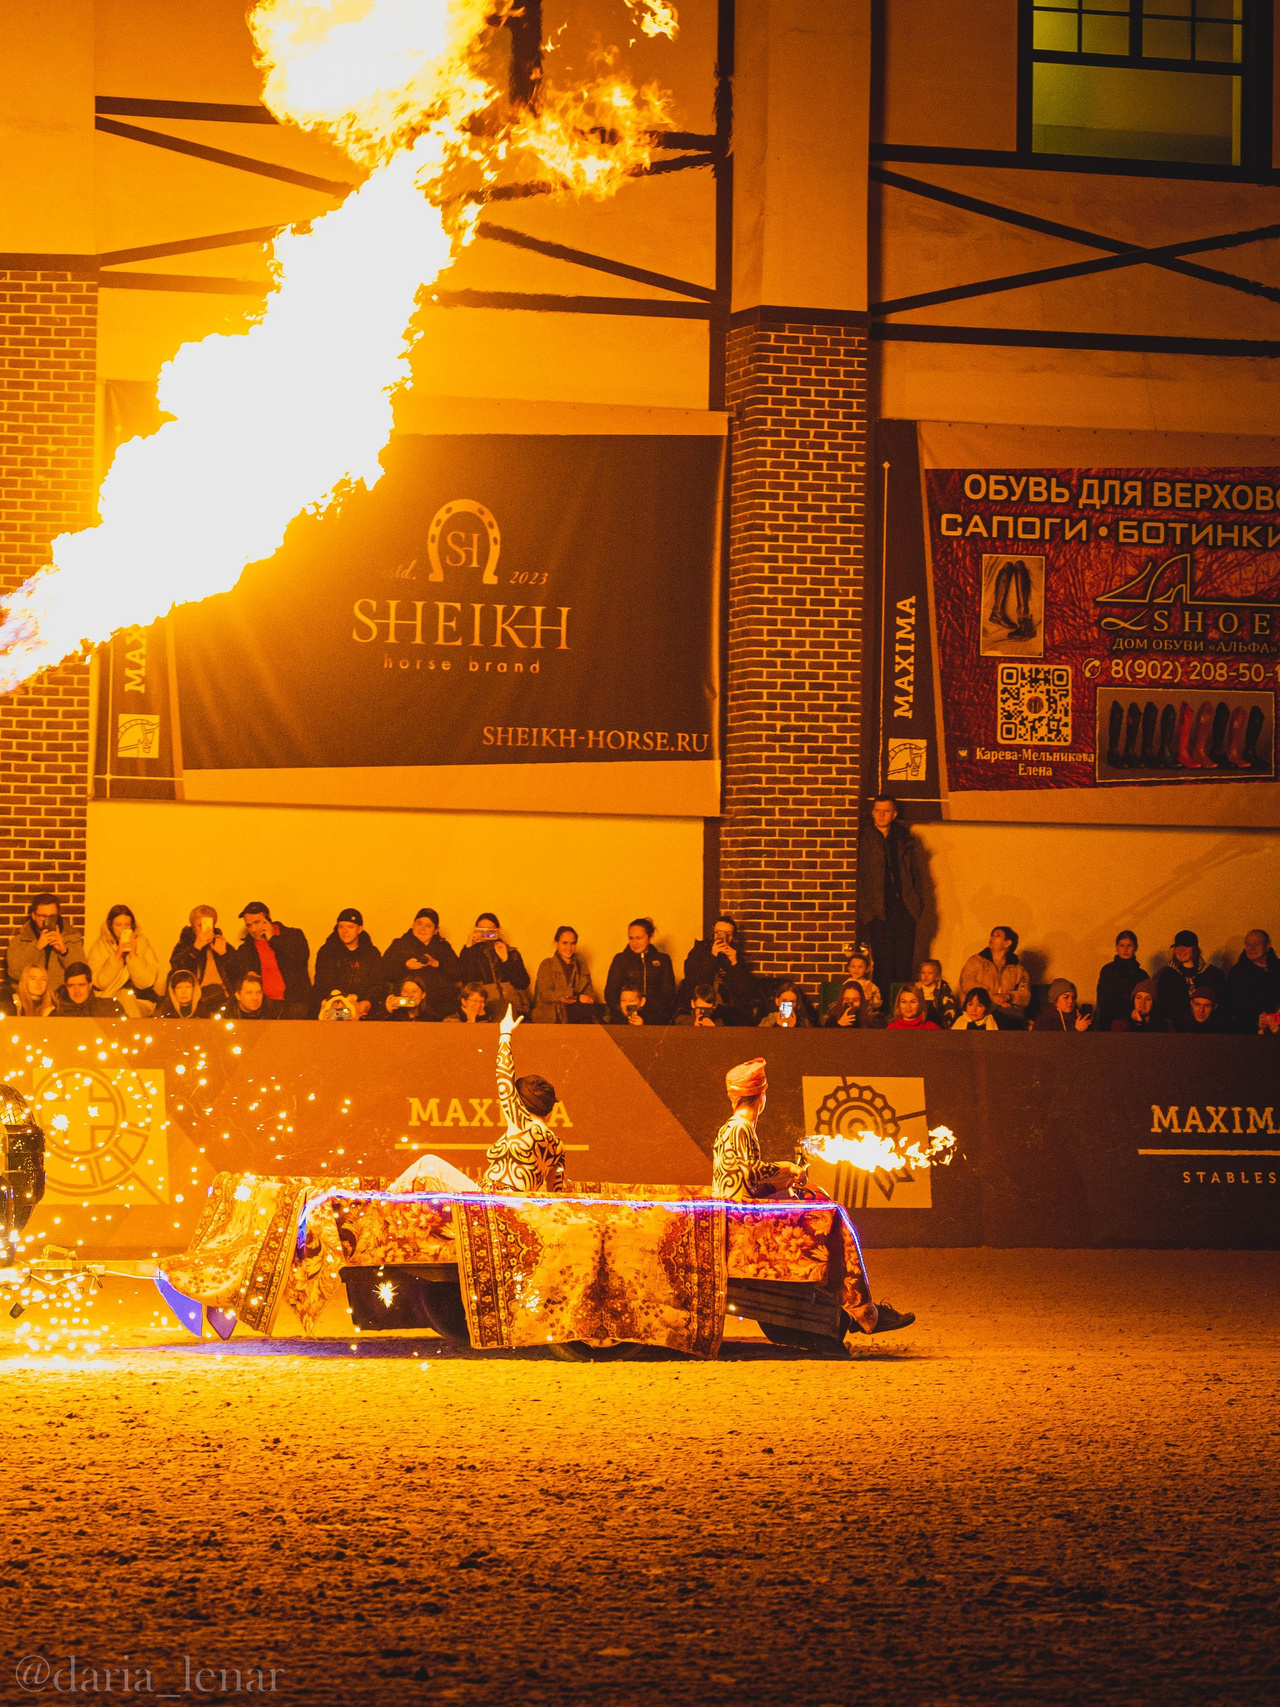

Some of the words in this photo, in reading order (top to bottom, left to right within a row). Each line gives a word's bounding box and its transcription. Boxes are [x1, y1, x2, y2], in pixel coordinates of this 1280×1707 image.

[964, 474, 1070, 503] ОБУВЬ
[1078, 478, 1143, 509] ДЛЯ
[1153, 481, 1280, 511] ВЕРХОВ
[940, 513, 1087, 541] САПОГИ
[509, 571, 549, 585] 2023
[352, 598, 572, 650] SHEIKH
[893, 595, 916, 719] MAXIMA
[1113, 638, 1148, 650] ДОМ
[1152, 639, 1204, 651] ОБУВИ
[383, 652, 451, 671] horse
[469, 652, 540, 673] brand
[1111, 659, 1182, 683] 8(902)
[482, 726, 709, 752] SHEIKH-HORSE.RU
[976, 747, 1095, 764] Карева-Мельникова
[1018, 763, 1053, 777] Елена
[408, 1097, 573, 1127] MAXIA
[1150, 1104, 1280, 1134] MAXIM
[1182, 1171, 1277, 1184] STABLES
